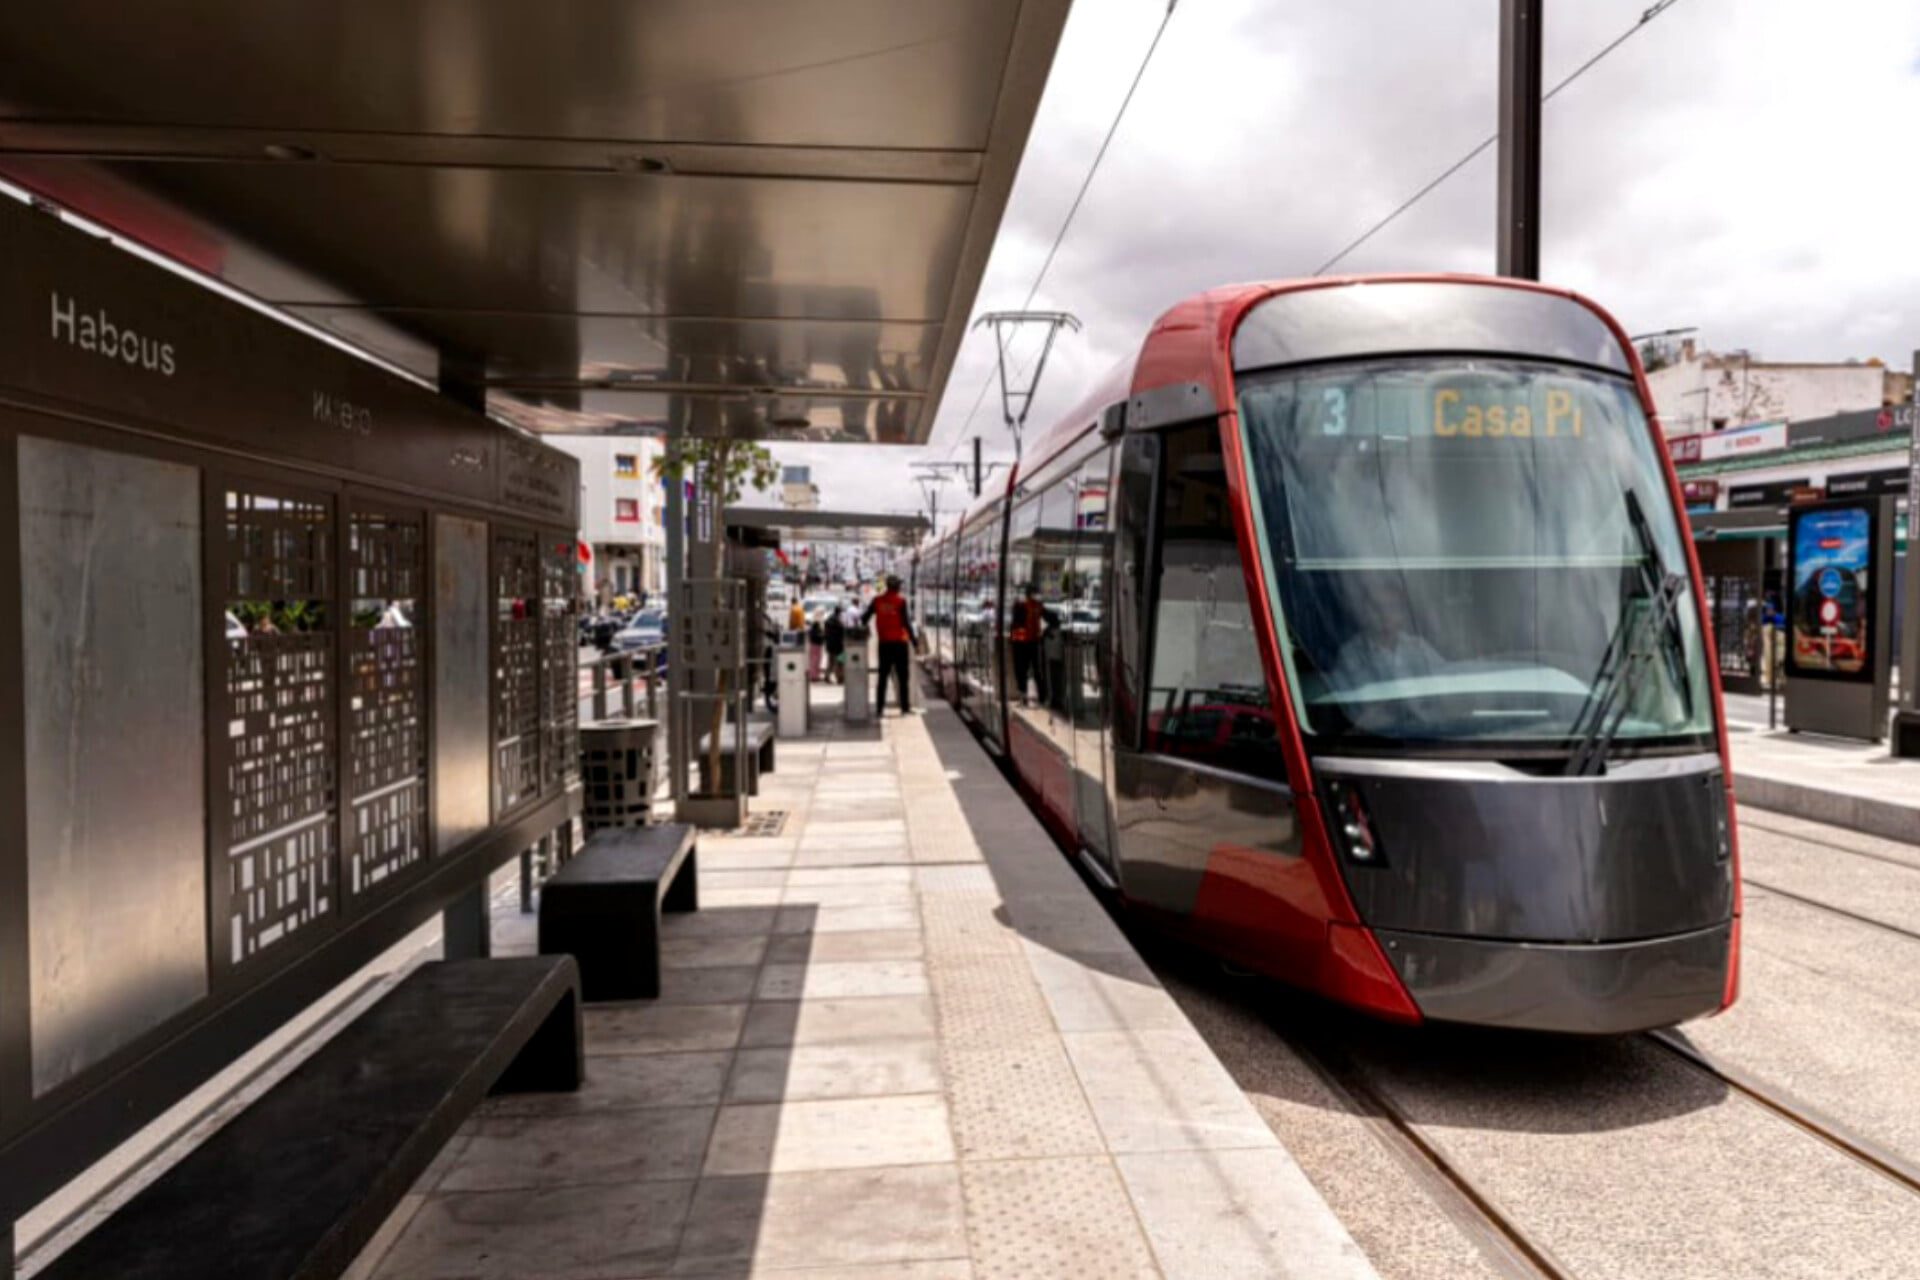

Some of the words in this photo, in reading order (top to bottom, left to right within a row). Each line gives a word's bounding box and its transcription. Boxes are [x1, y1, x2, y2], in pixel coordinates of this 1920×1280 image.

[51, 290, 175, 376] Habous
[1323, 387, 1346, 435] 3
[1434, 388, 1531, 437] Casa
